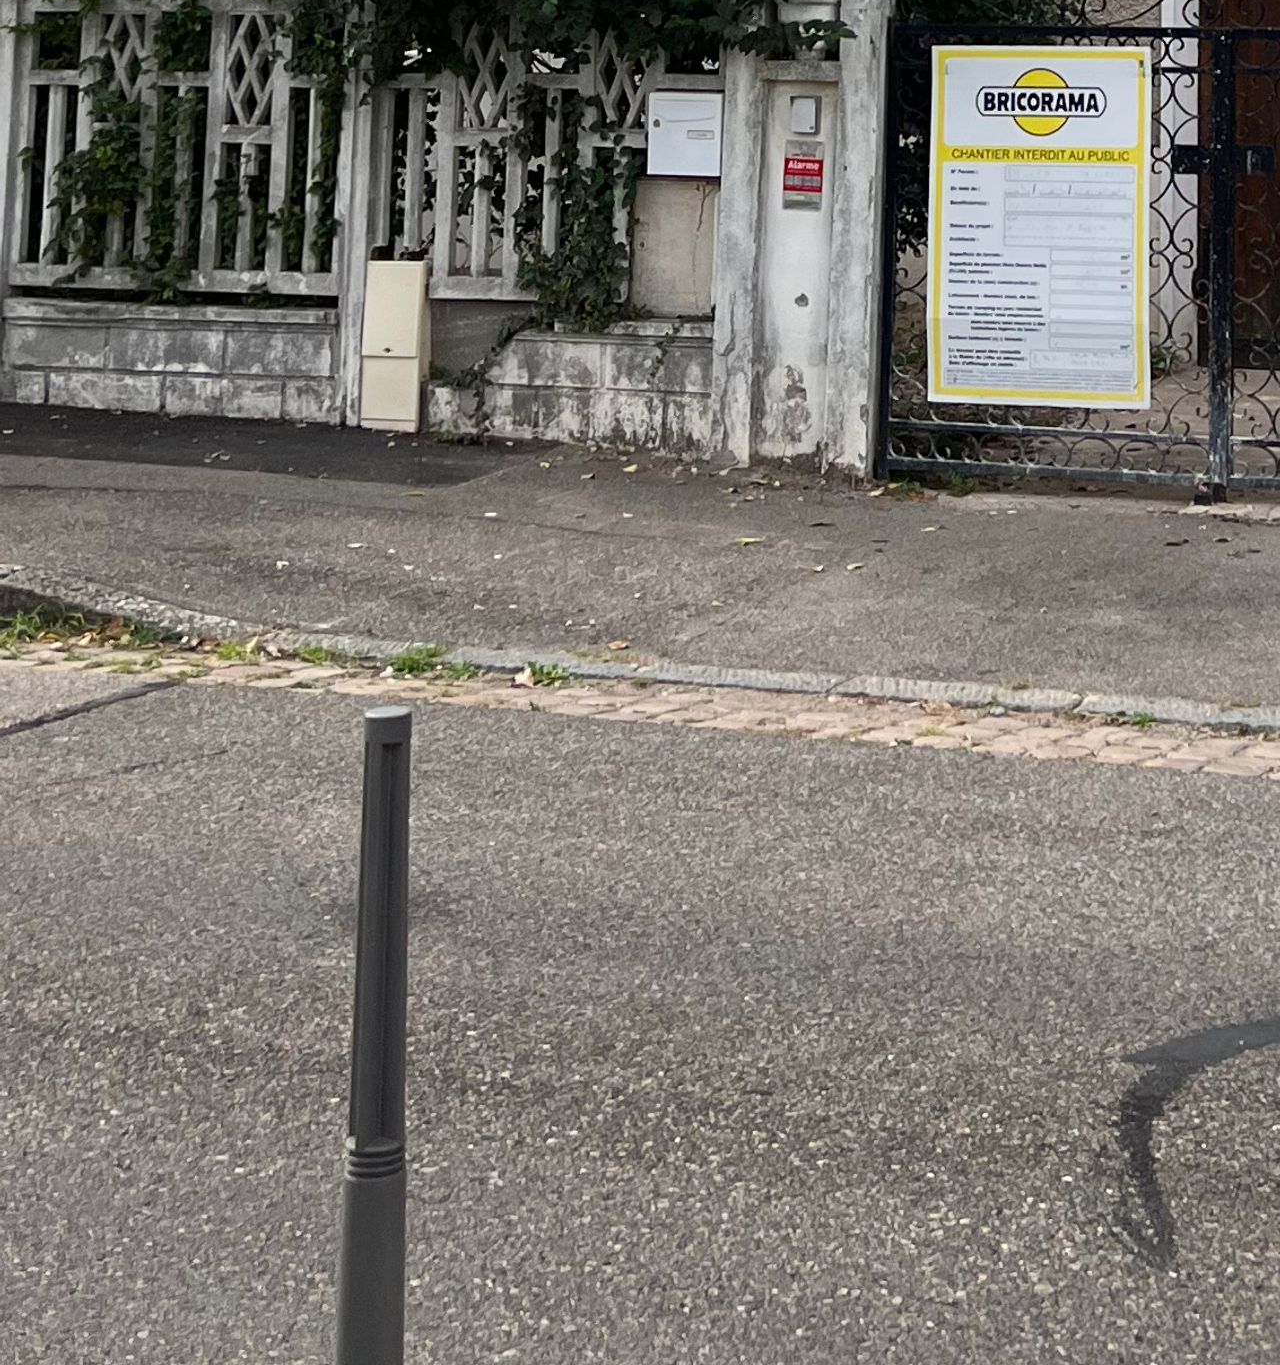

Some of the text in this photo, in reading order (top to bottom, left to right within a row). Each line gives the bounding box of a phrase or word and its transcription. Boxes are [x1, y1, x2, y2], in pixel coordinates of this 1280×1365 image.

[983, 92, 1099, 112] BRICORAMA
[952, 148, 1130, 162] CHANTIER INTERDIT AU PUBLIC
[788, 160, 820, 170] Alarme
